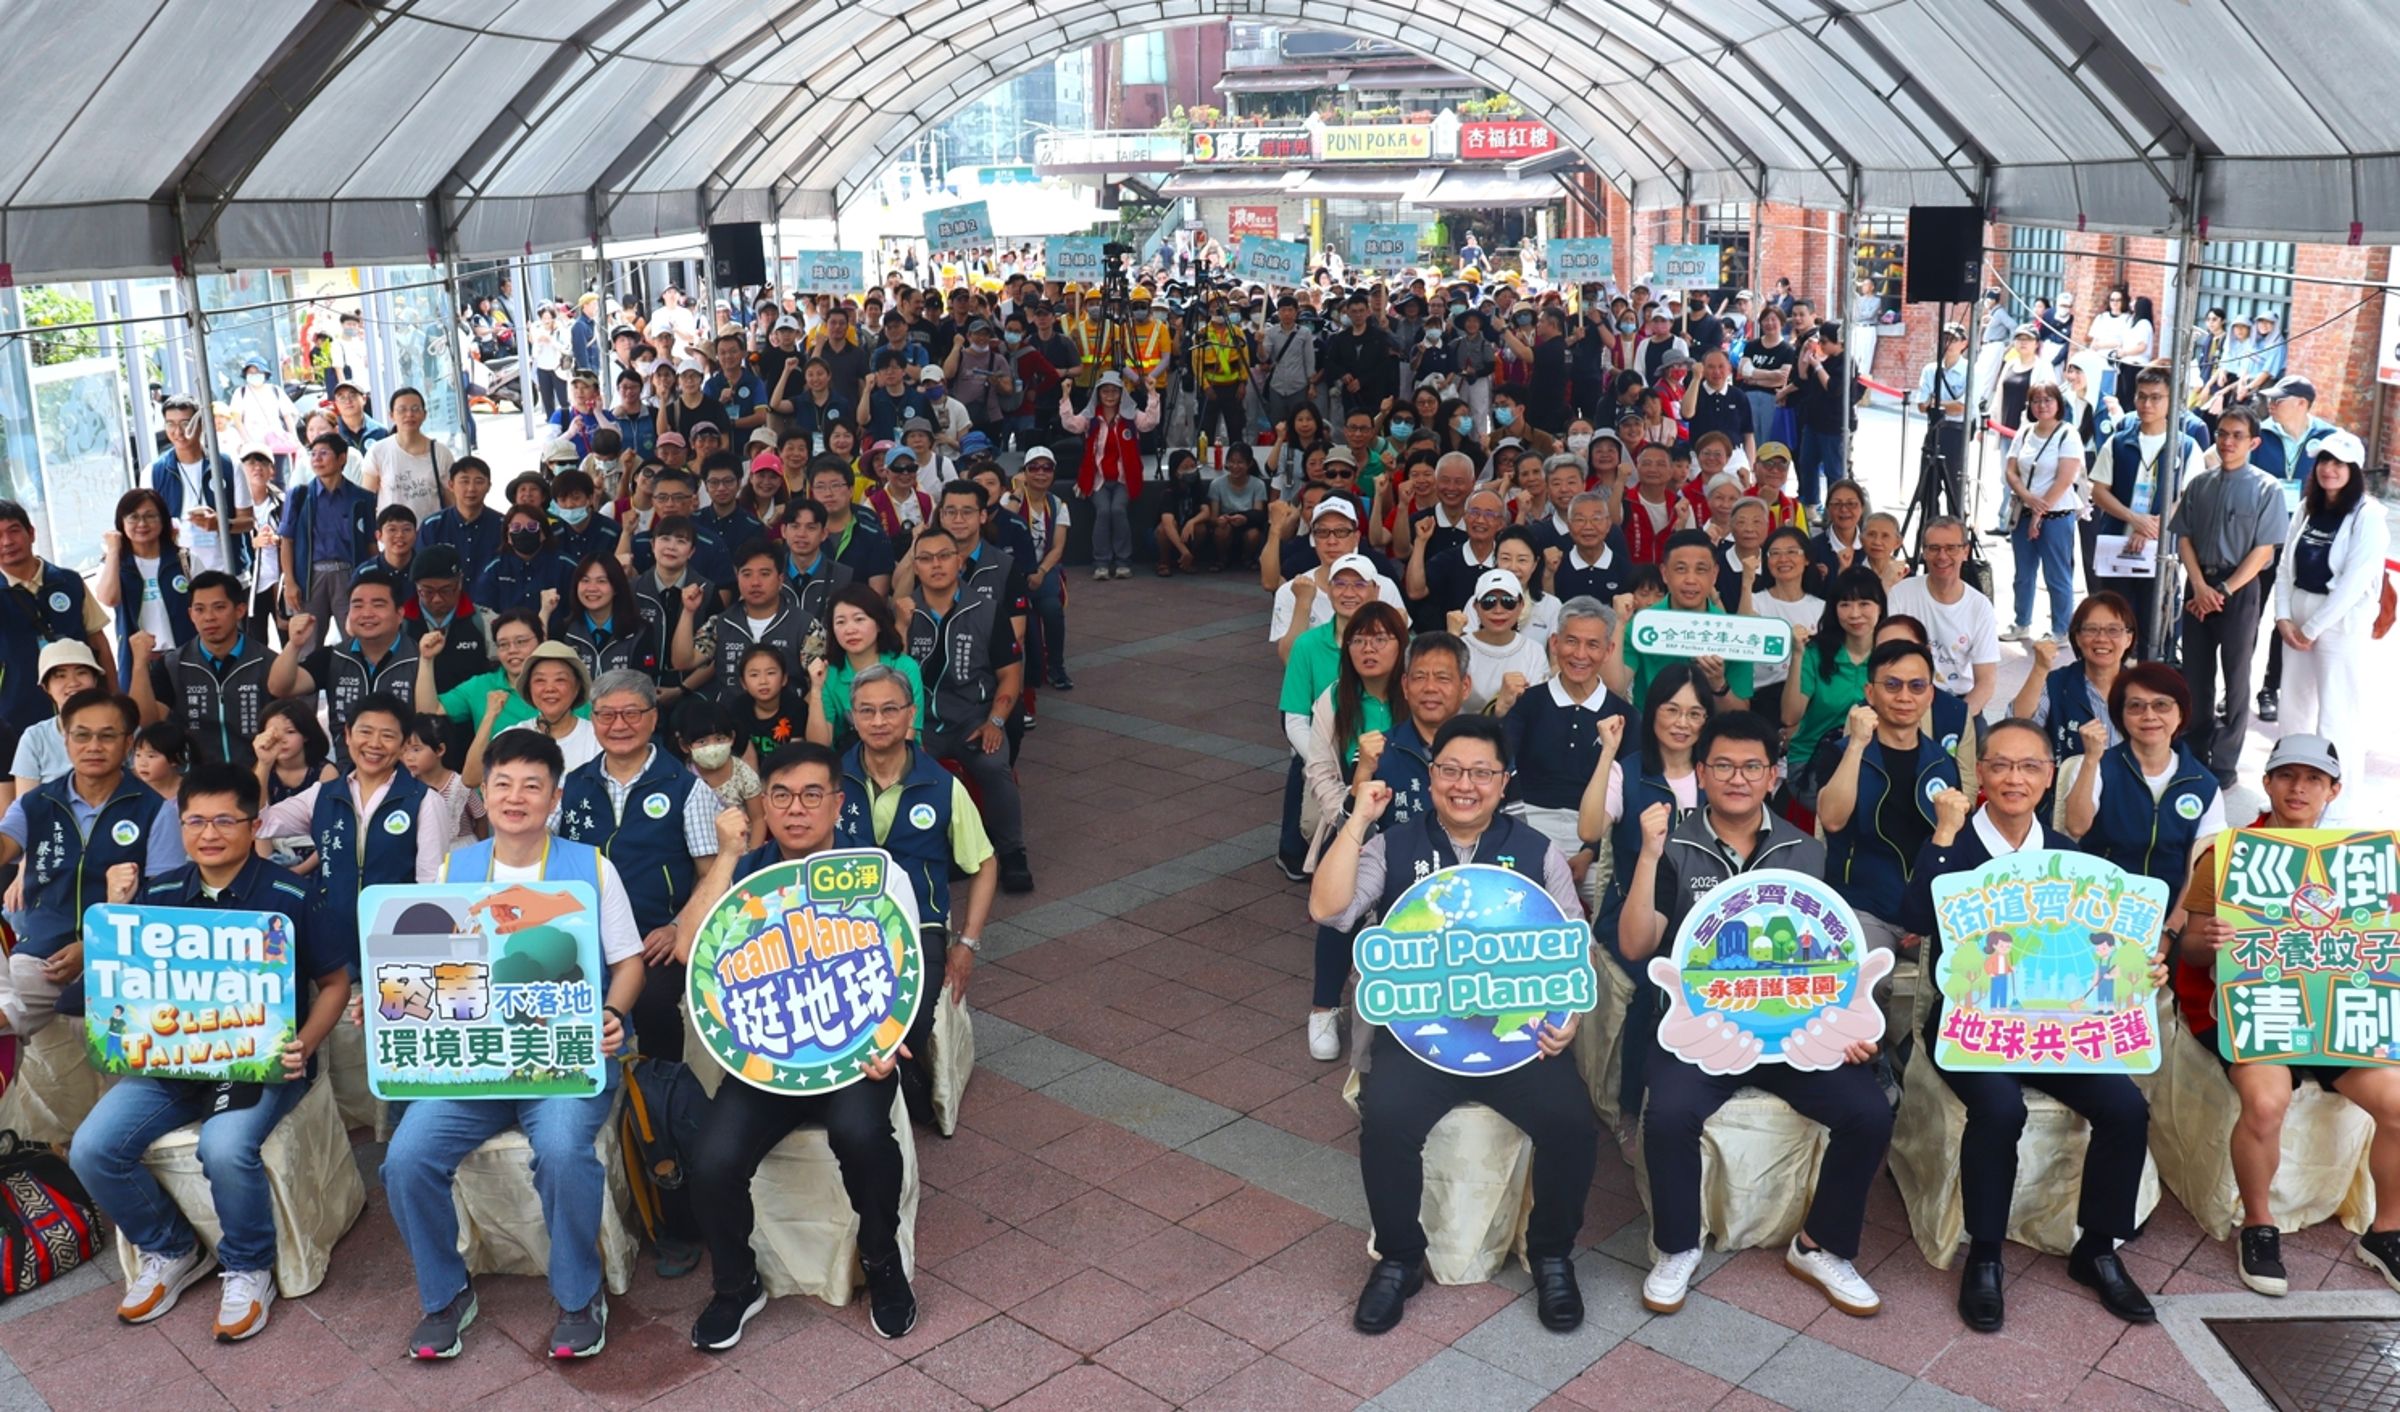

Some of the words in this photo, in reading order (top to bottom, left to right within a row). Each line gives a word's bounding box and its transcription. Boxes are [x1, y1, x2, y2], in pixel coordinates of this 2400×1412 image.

[1327, 133, 1362, 151] PUNI
[1366, 132, 1407, 150] POKA
[1467, 127, 1549, 149] 杏福紅樓
[456, 642, 470, 650] JCI
[580, 797, 595, 829] 次長
[847, 802, 861, 834] 次長
[1690, 876, 1719, 889] 2025
[1942, 880, 2159, 943] 街道齊心護
[107, 913, 264, 962] Team
[717, 927, 790, 986] Team
[786, 906, 881, 965] Planet
[1363, 934, 1437, 971] Our
[1446, 927, 1582, 966] Power
[2233, 929, 2400, 971] 不養蚊子
[91, 958, 281, 1004] Taiwan
[377, 962, 490, 1021] 菸蒂
[493, 982, 594, 1018] 不落地
[728, 950, 893, 1053] 挺地球
[1366, 980, 1441, 1016] Our
[1449, 968, 1588, 1012] Planet
[1709, 975, 1836, 999] 永續護家園
[377, 1025, 597, 1068] 環境更美麗
[1943, 1008, 2153, 1062] 地球共守護
